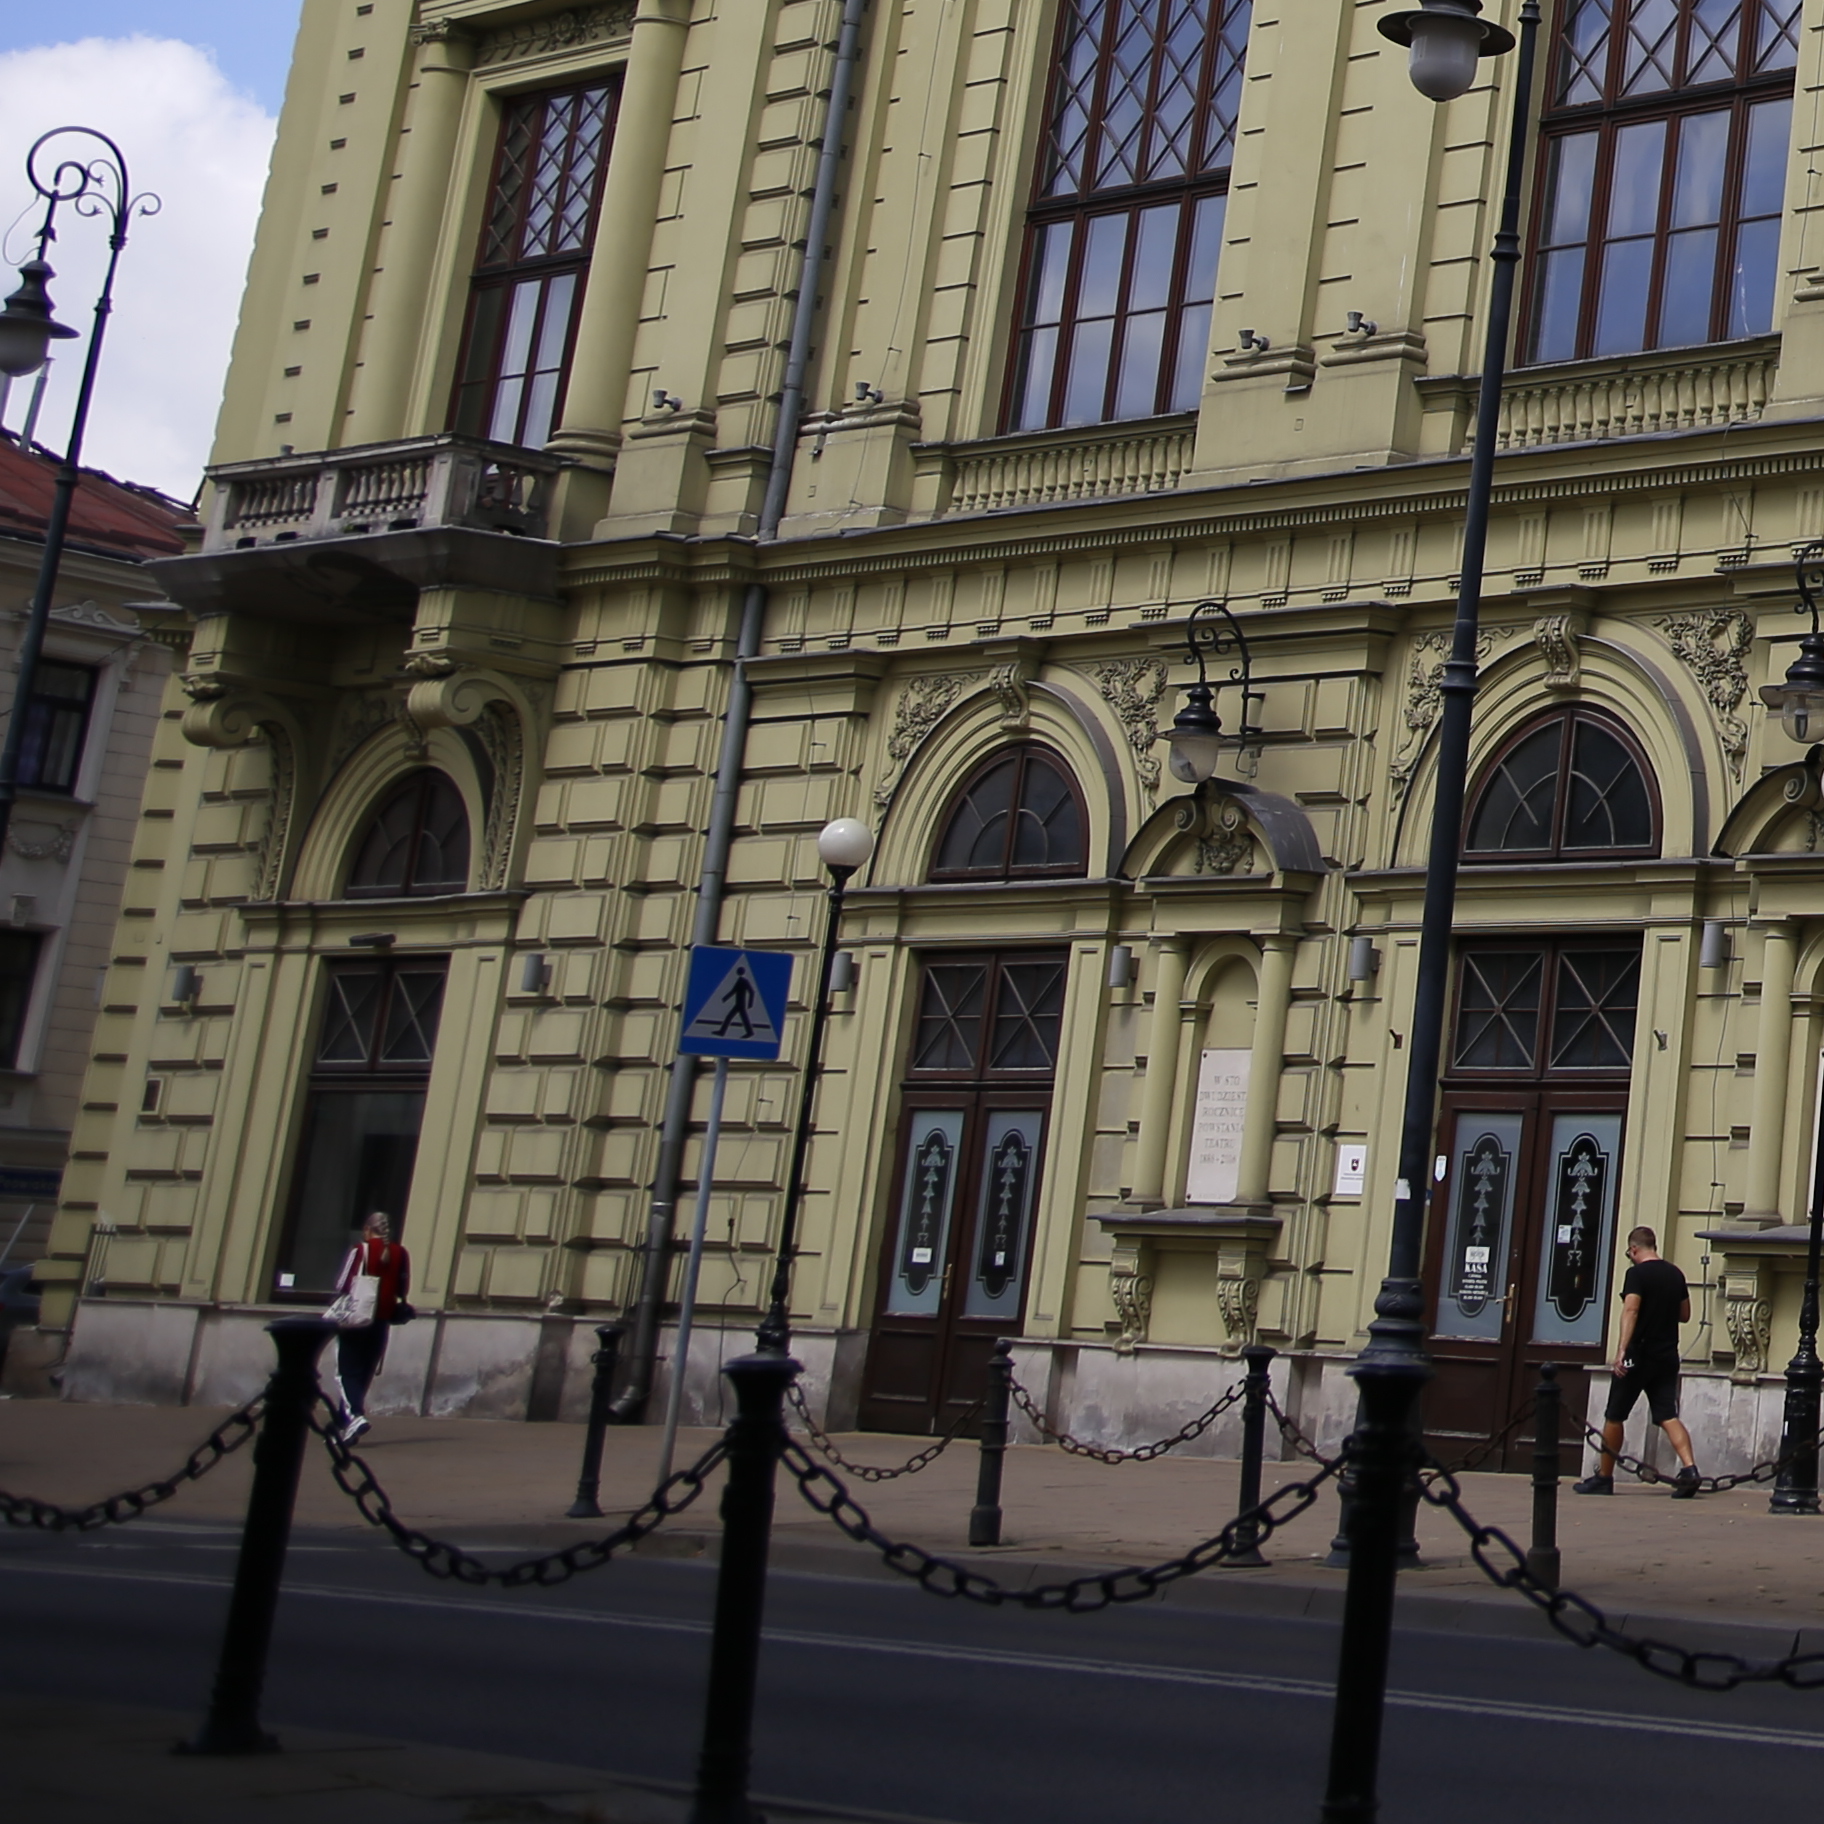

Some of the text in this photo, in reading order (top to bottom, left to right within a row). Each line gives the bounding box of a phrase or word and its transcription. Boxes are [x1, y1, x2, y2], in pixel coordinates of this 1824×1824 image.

[1225, 1075, 1240, 1086] STO
[1199, 1091, 1247, 1102] DWUDZIEST
[1464, 1262, 1488, 1273] KASA
